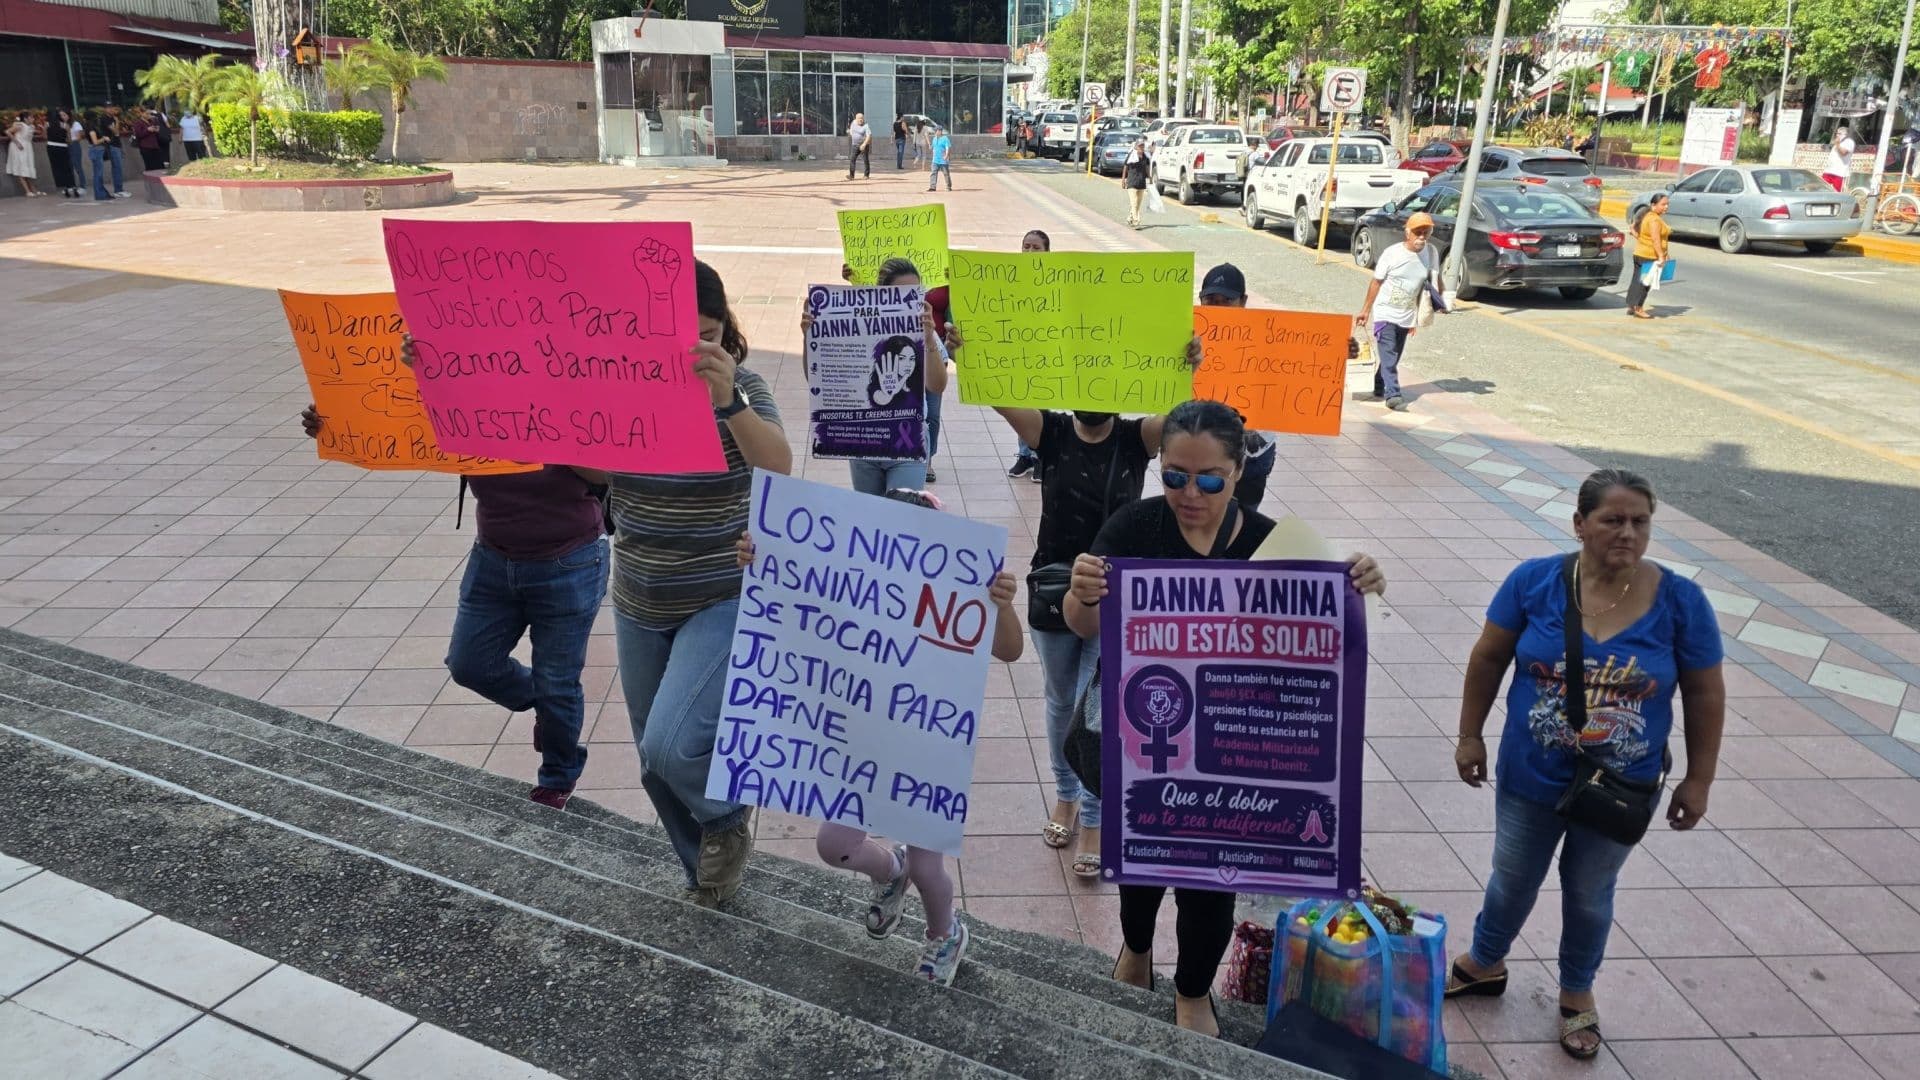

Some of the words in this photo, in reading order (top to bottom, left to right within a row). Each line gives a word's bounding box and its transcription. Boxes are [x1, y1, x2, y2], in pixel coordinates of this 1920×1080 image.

[1626, 56, 1635, 73] 9
[1706, 57, 1716, 73] 7
[1334, 77, 1355, 103] E
[952, 255, 1019, 284] Danna
[1032, 258, 1107, 287] Yannina
[1120, 266, 1145, 284] es
[1153, 266, 1190, 284] una
[324, 301, 404, 337] Danna
[416, 286, 552, 330] Justicia
[559, 291, 647, 340] Para
[811, 318, 860, 339] DANNA
[864, 315, 924, 336] YANINA!!
[853, 307, 880, 318] PARA
[1193, 312, 1253, 342] Danna
[1265, 317, 1332, 347] Yannina
[325, 345, 341, 375] y
[347, 345, 397, 376] soy
[412, 340, 529, 380] Danna
[961, 346, 1064, 370] Libertad
[1073, 352, 1114, 374] para
[1122, 350, 1190, 372] Danna
[569, 410, 659, 450] SOLA!
[855, 411, 863, 420] TE
[865, 409, 893, 419] CREEMOS
[317, 415, 400, 460] Justicia
[758, 475, 836, 553] LOS
[848, 525, 979, 586] NIÑOS
[985, 548, 1004, 588] Y
[803, 564, 907, 620] NIÑAS
[913, 582, 987, 649] NO
[1131, 576, 1225, 613] DANNA
[1234, 576, 1338, 617] YANINA
[742, 584, 784, 625] SE
[793, 602, 920, 668] TOCAN
[1133, 622, 1179, 652] ¡¡NO
[1187, 618, 1255, 656] ESTÁS
[1262, 627, 1335, 659] SOLA!!
[731, 629, 873, 713] JUSTICIA
[887, 682, 976, 746] PARA
[1205, 671, 1232, 683] Danna
[1233, 672, 1268, 684] también
[1270, 674, 1284, 686] fué
[1320, 678, 1331, 690] de
[728, 677, 848, 744] DAFNE
[1203, 704, 1246, 716] agresiones
[1275, 710, 1281, 721] y
[1283, 710, 1334, 724] psicológicas
[1280, 692, 1314, 705] torturas
[1315, 696, 1321, 708] y
[1213, 737, 1260, 752] Academia
[1214, 720, 1247, 734] durante
[1248, 725, 1259, 735] su
[1260, 726, 1297, 738] estancia
[1298, 730, 1309, 739] en
[1310, 727, 1319, 739] la
[716, 716, 879, 793] JUSTICIA
[890, 771, 968, 824] PARA
[1221, 754, 1233, 767] de
[1235, 755, 1269, 770] Marina
[1161, 782, 1199, 808] Que
[1204, 786, 1224, 809] el
[1228, 788, 1279, 812] dolor
[1137, 812, 1157, 826] no
[1162, 809, 1178, 827] te
[1182, 815, 1208, 829] sea
[1213, 813, 1297, 837] indiferente
